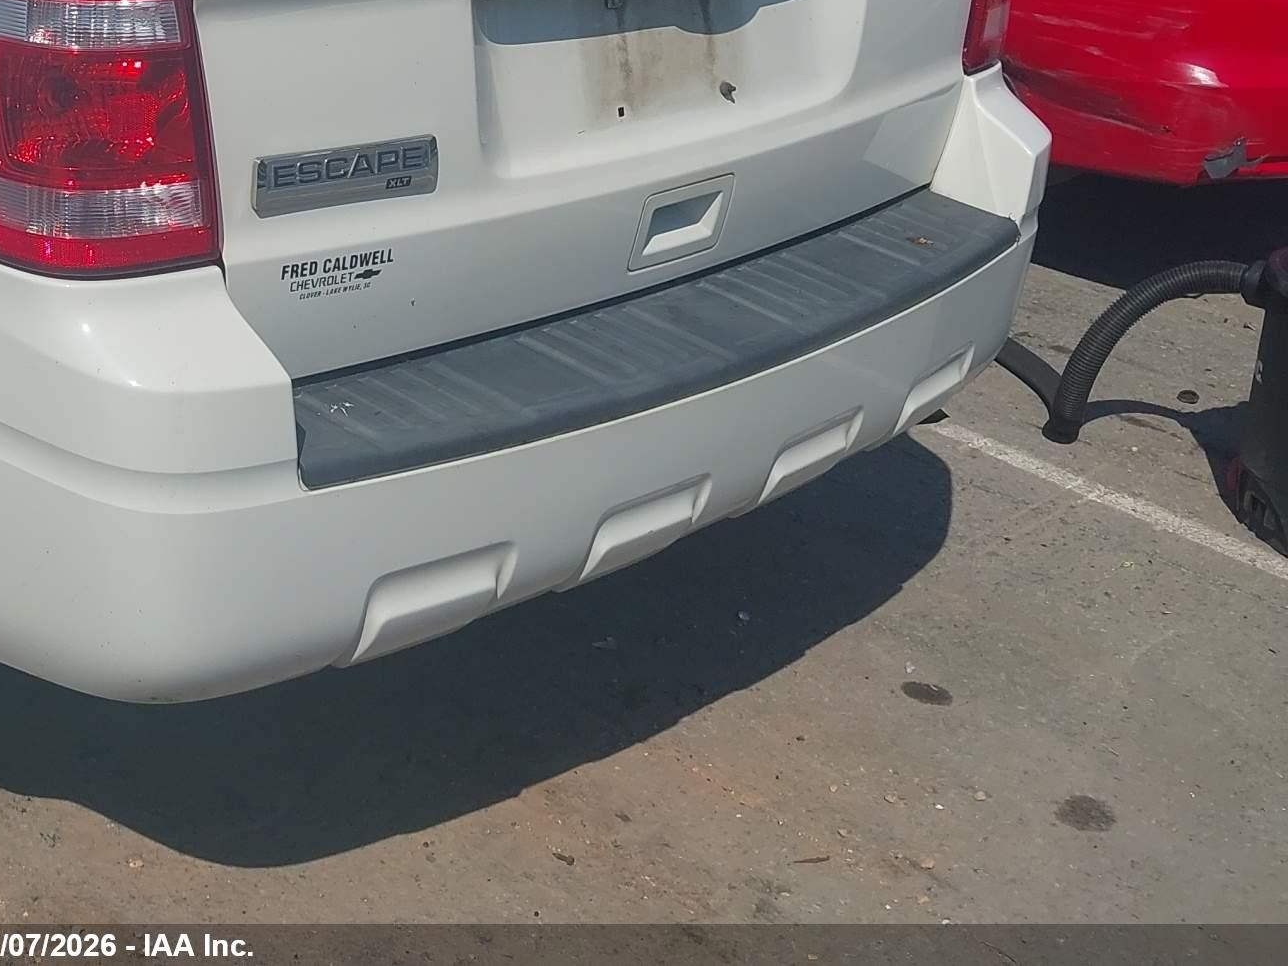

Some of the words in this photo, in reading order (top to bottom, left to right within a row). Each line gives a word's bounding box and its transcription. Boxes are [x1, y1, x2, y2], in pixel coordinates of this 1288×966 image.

[272, 147, 424, 187] ESCAPE
[388, 177, 409, 188] XLT
[281, 261, 318, 280] FRED
[322, 248, 394, 274] CALDWELL
[290, 272, 354, 292] CHEVROLET
